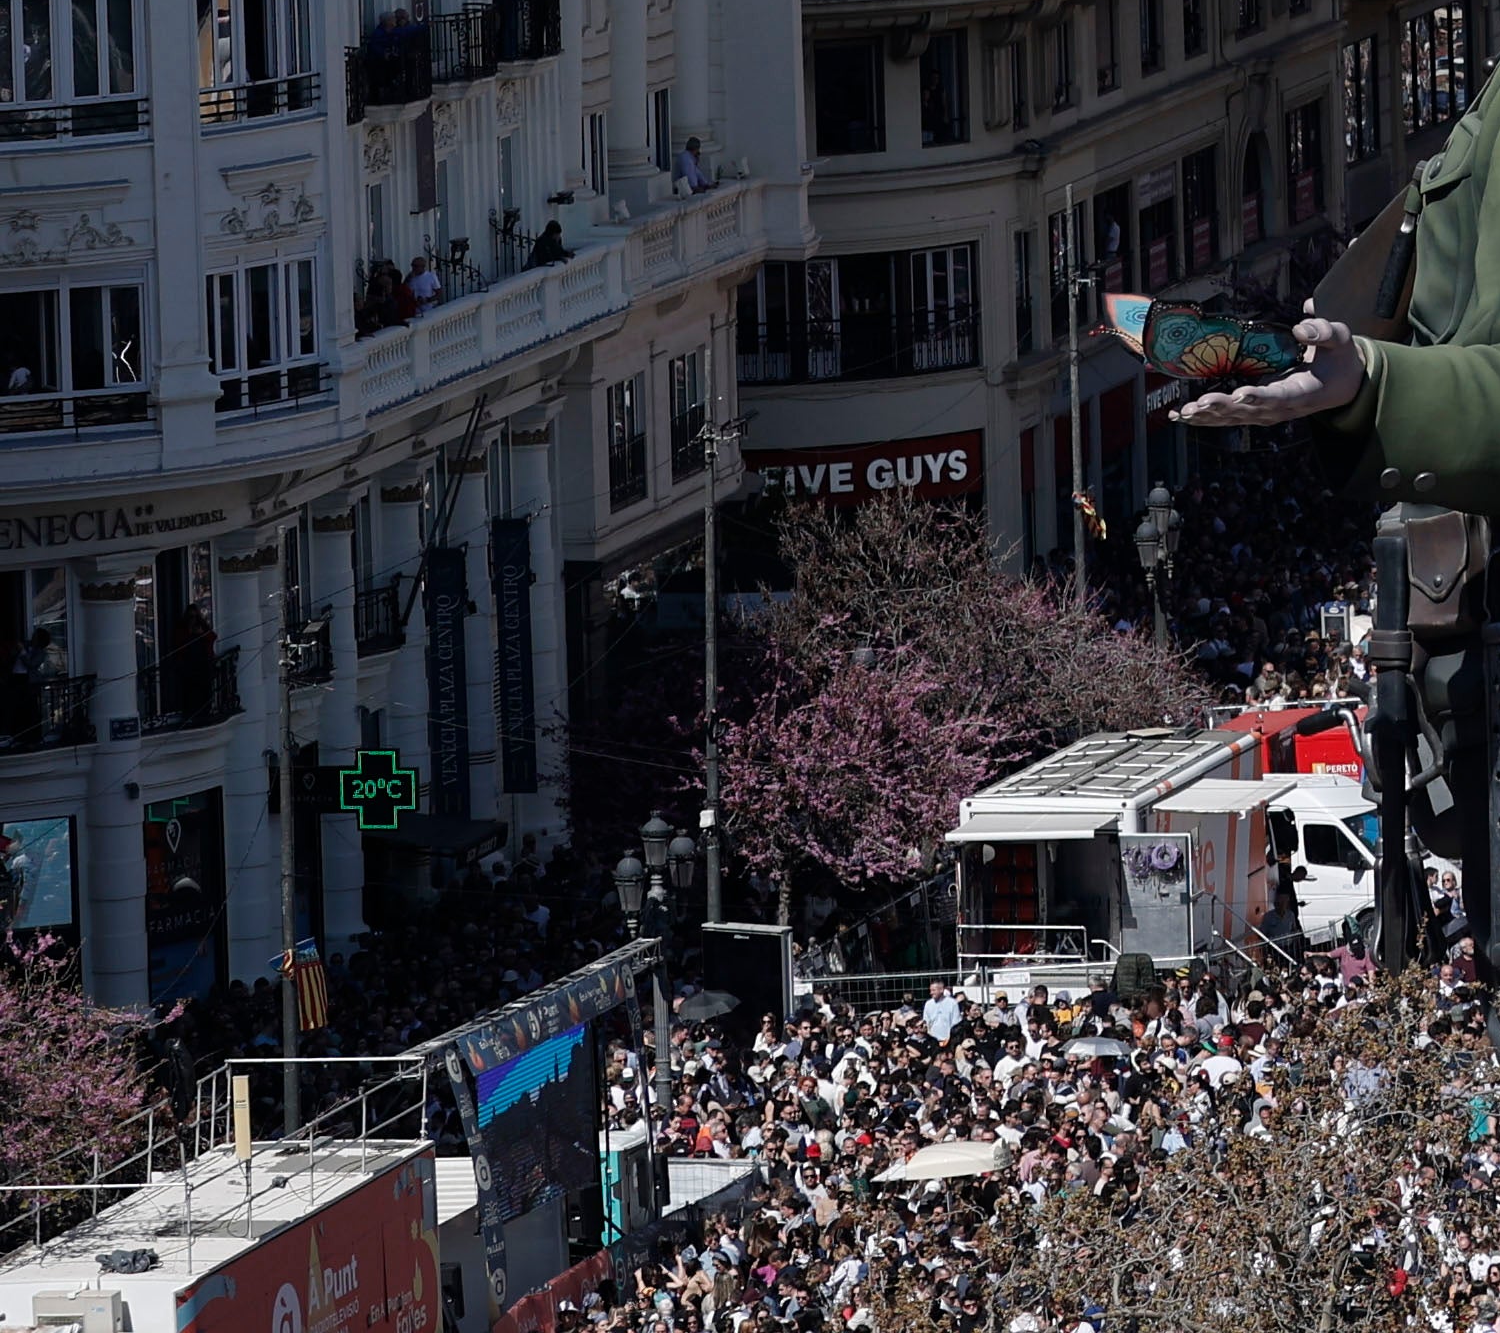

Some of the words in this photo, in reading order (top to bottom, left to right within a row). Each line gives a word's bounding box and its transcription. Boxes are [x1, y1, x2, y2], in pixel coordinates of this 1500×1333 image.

[866, 448, 969, 491] GUYS
[0, 507, 133, 551] ENECIA
[436, 593, 461, 666] CENTRO
[324, 1254, 359, 1306] Punt
